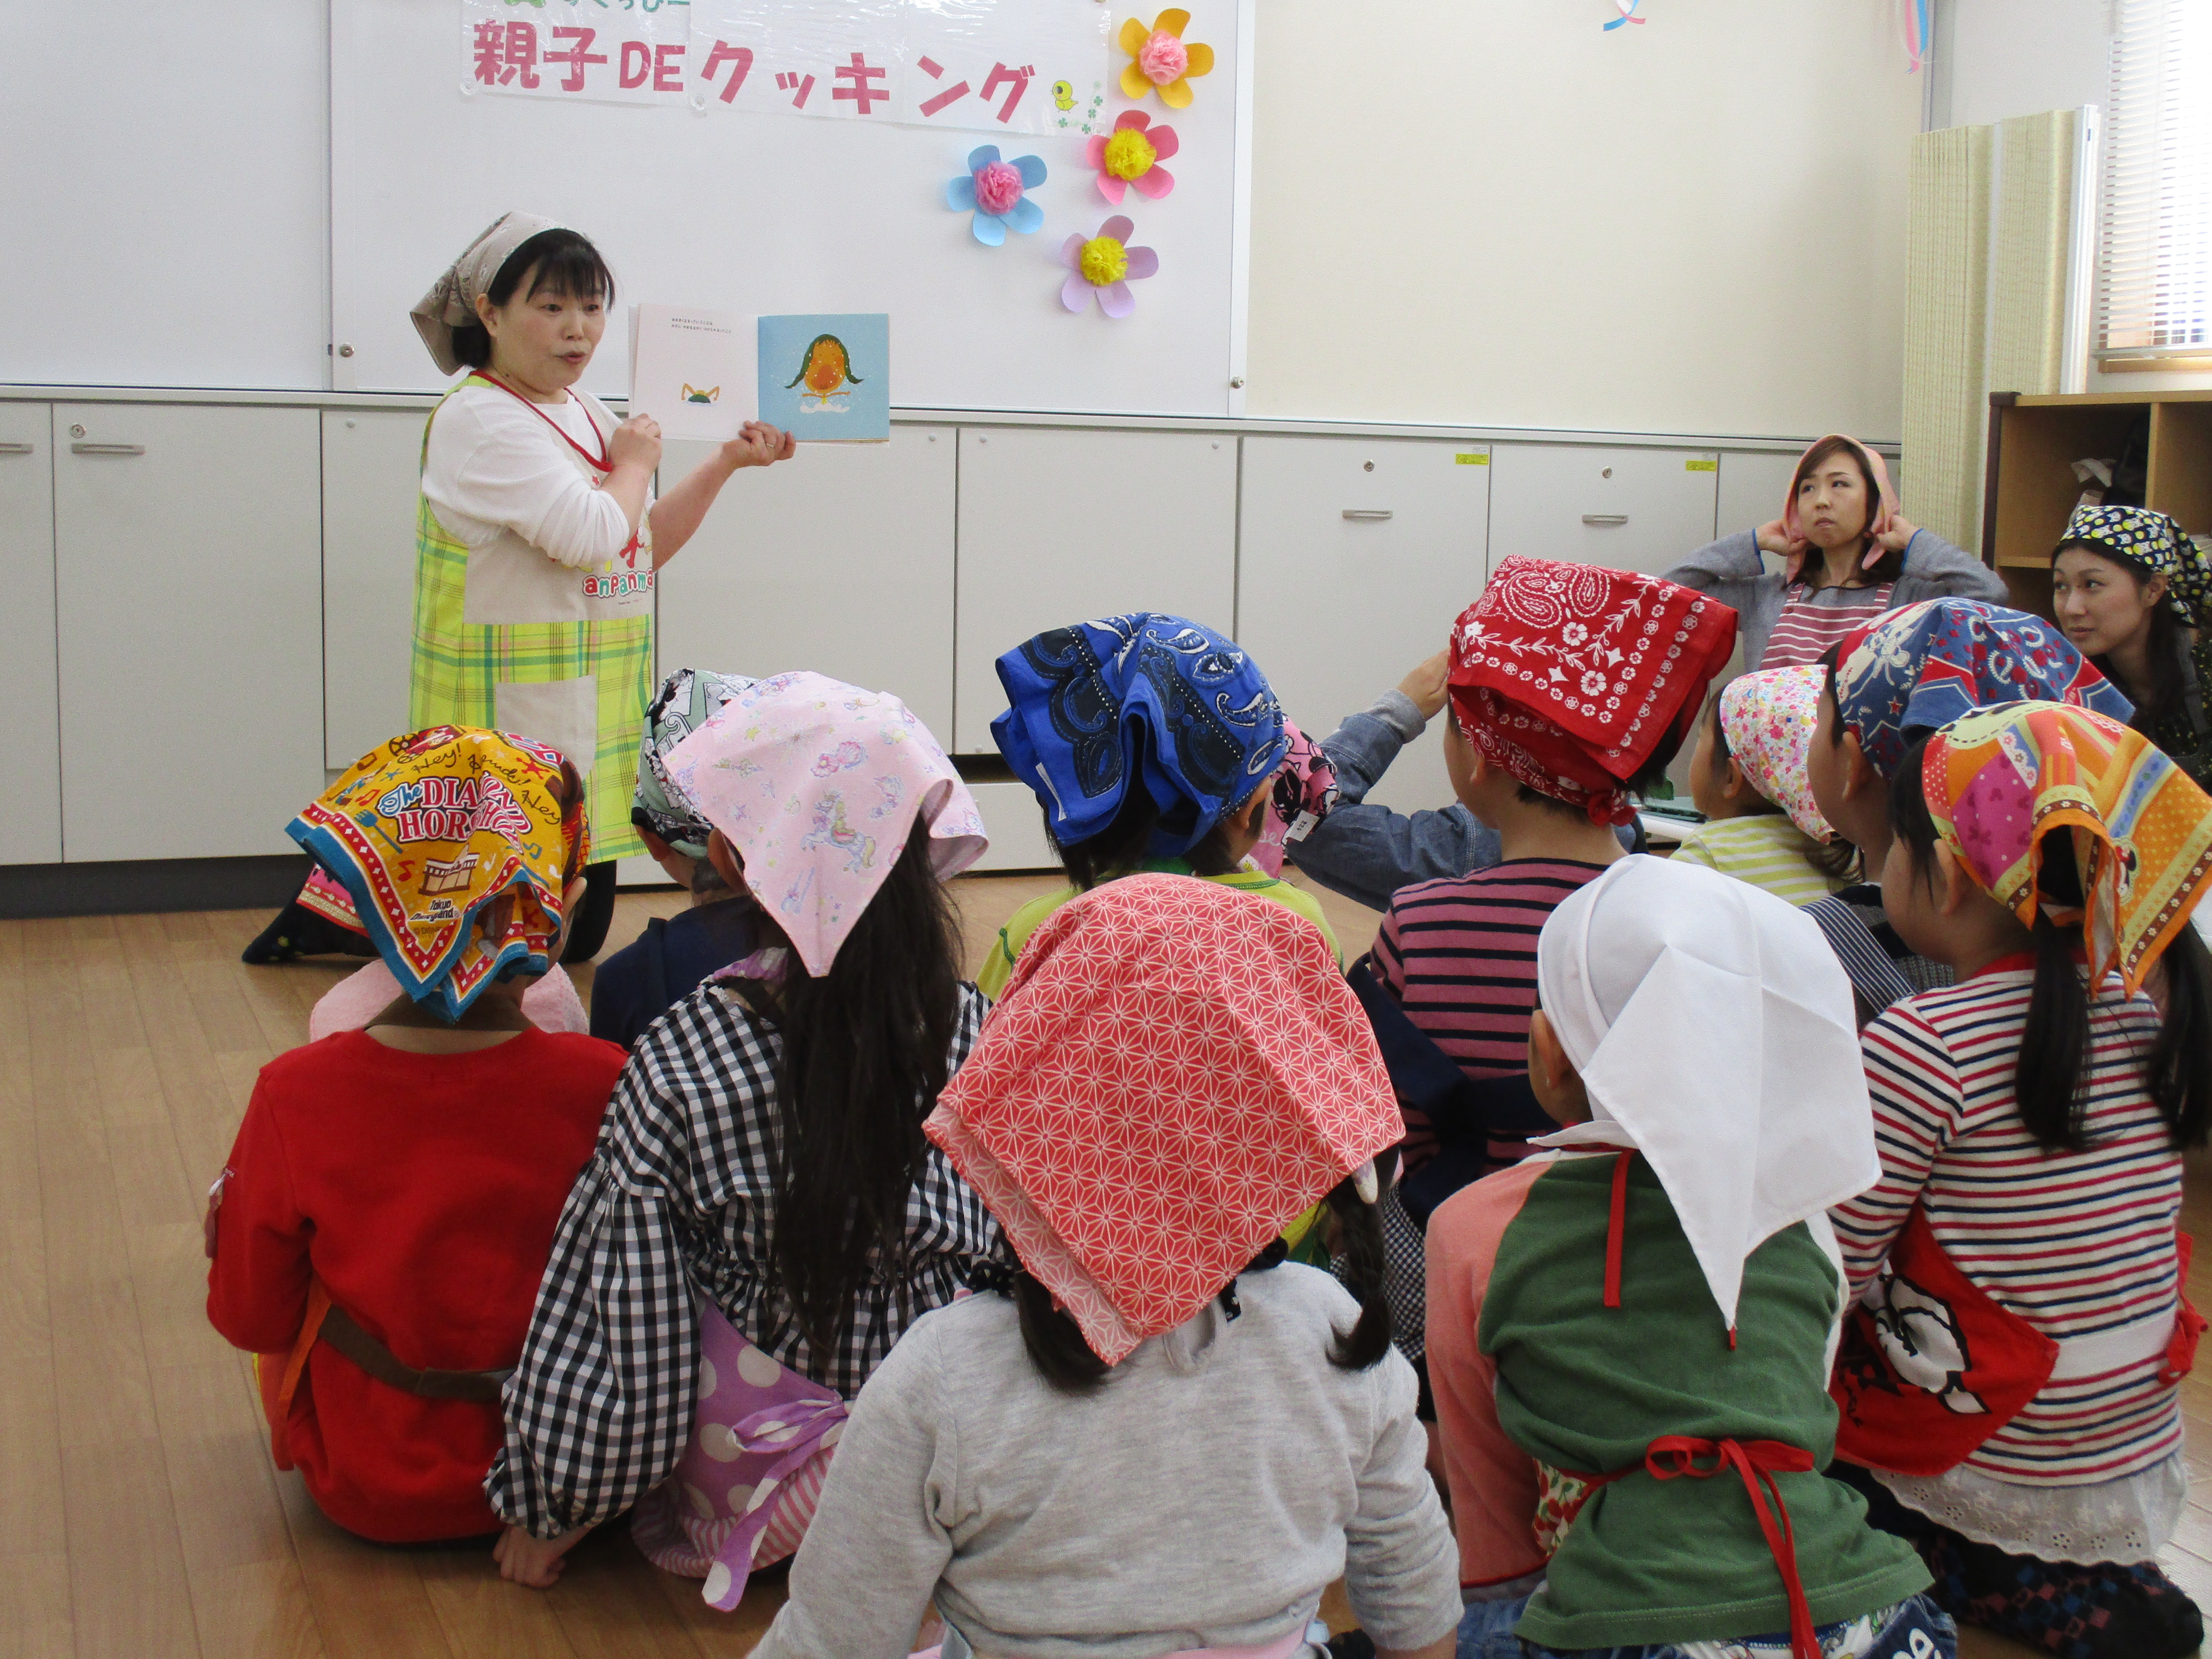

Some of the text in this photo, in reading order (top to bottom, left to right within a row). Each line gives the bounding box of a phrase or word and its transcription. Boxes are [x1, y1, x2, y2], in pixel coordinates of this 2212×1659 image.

[474, 18, 1036, 124] 親子DEクッキング
[378, 782, 423, 817] The
